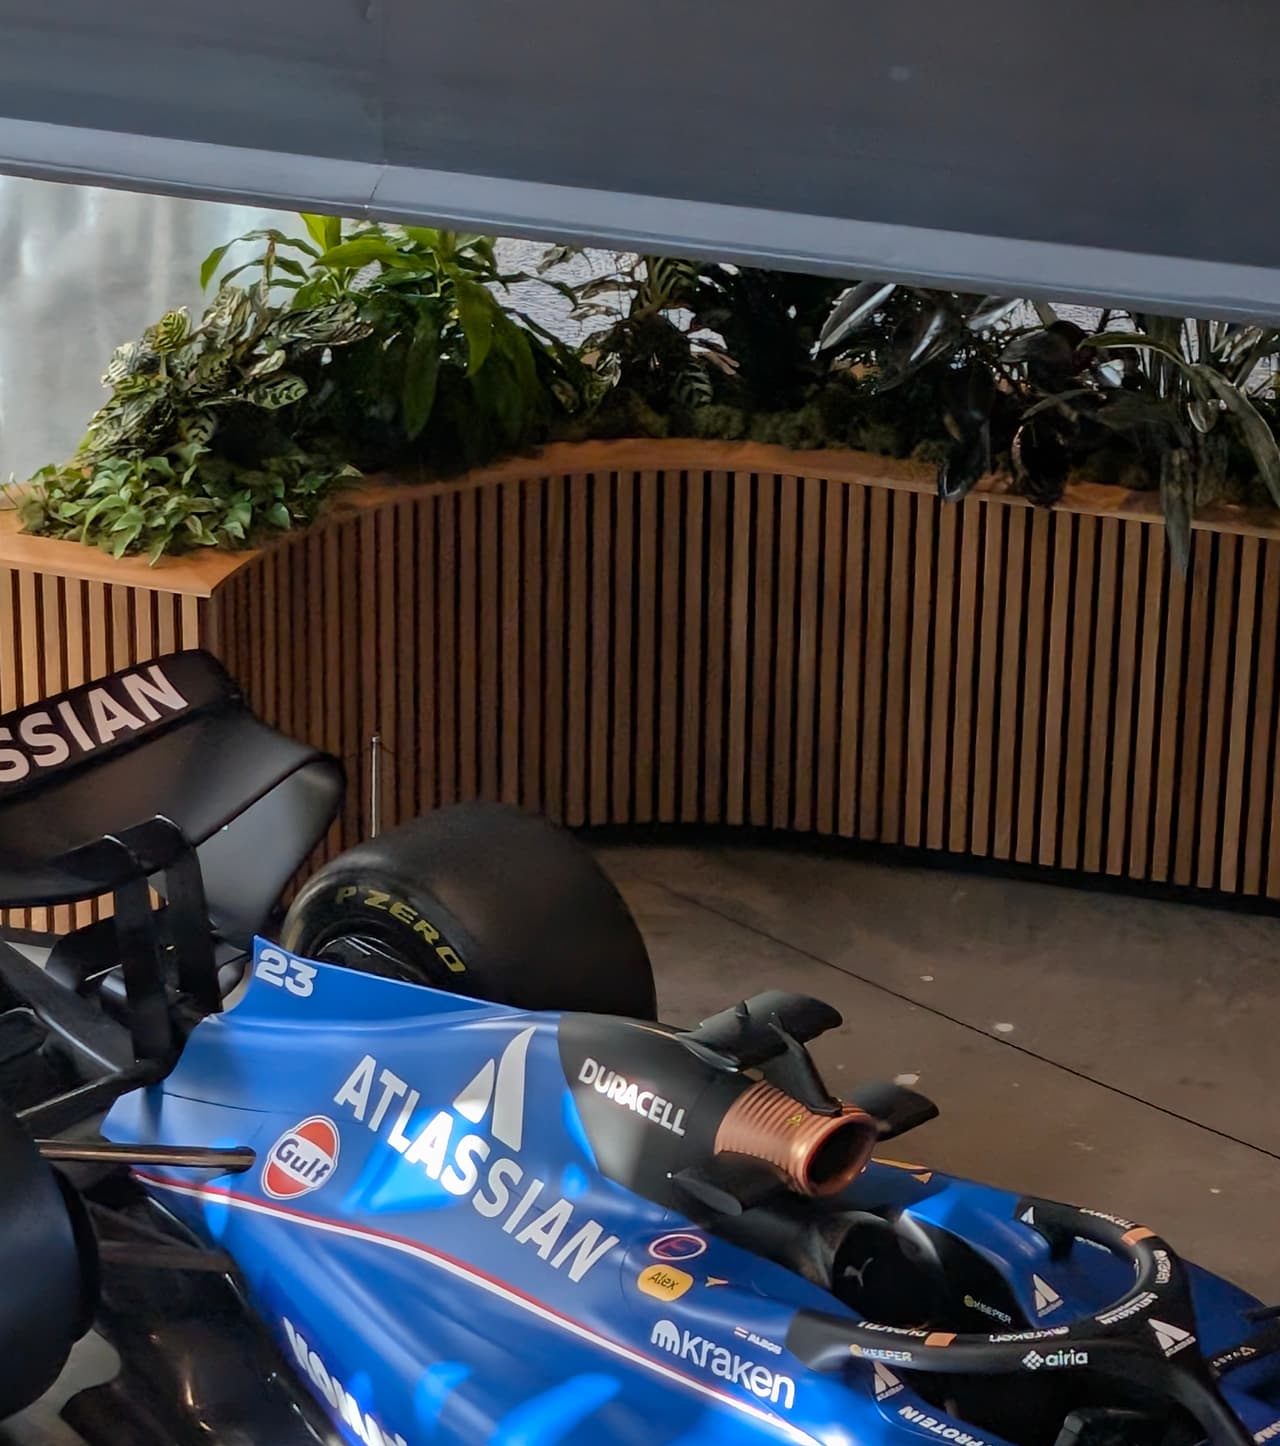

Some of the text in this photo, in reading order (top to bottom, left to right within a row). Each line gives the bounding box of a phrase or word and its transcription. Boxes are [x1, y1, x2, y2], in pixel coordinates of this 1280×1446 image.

[363, 889, 467, 973] ZERO
[255, 949, 318, 998] 23
[578, 1058, 686, 1137] DURACELL
[275, 1136, 332, 1188] Gulf
[333, 1054, 620, 1284] ATLASSIAN
[647, 1271, 679, 1291] Alex
[679, 1330, 796, 1409] kraken
[862, 1347, 913, 1363] KEEPER
[1045, 1348, 1088, 1367] airia
